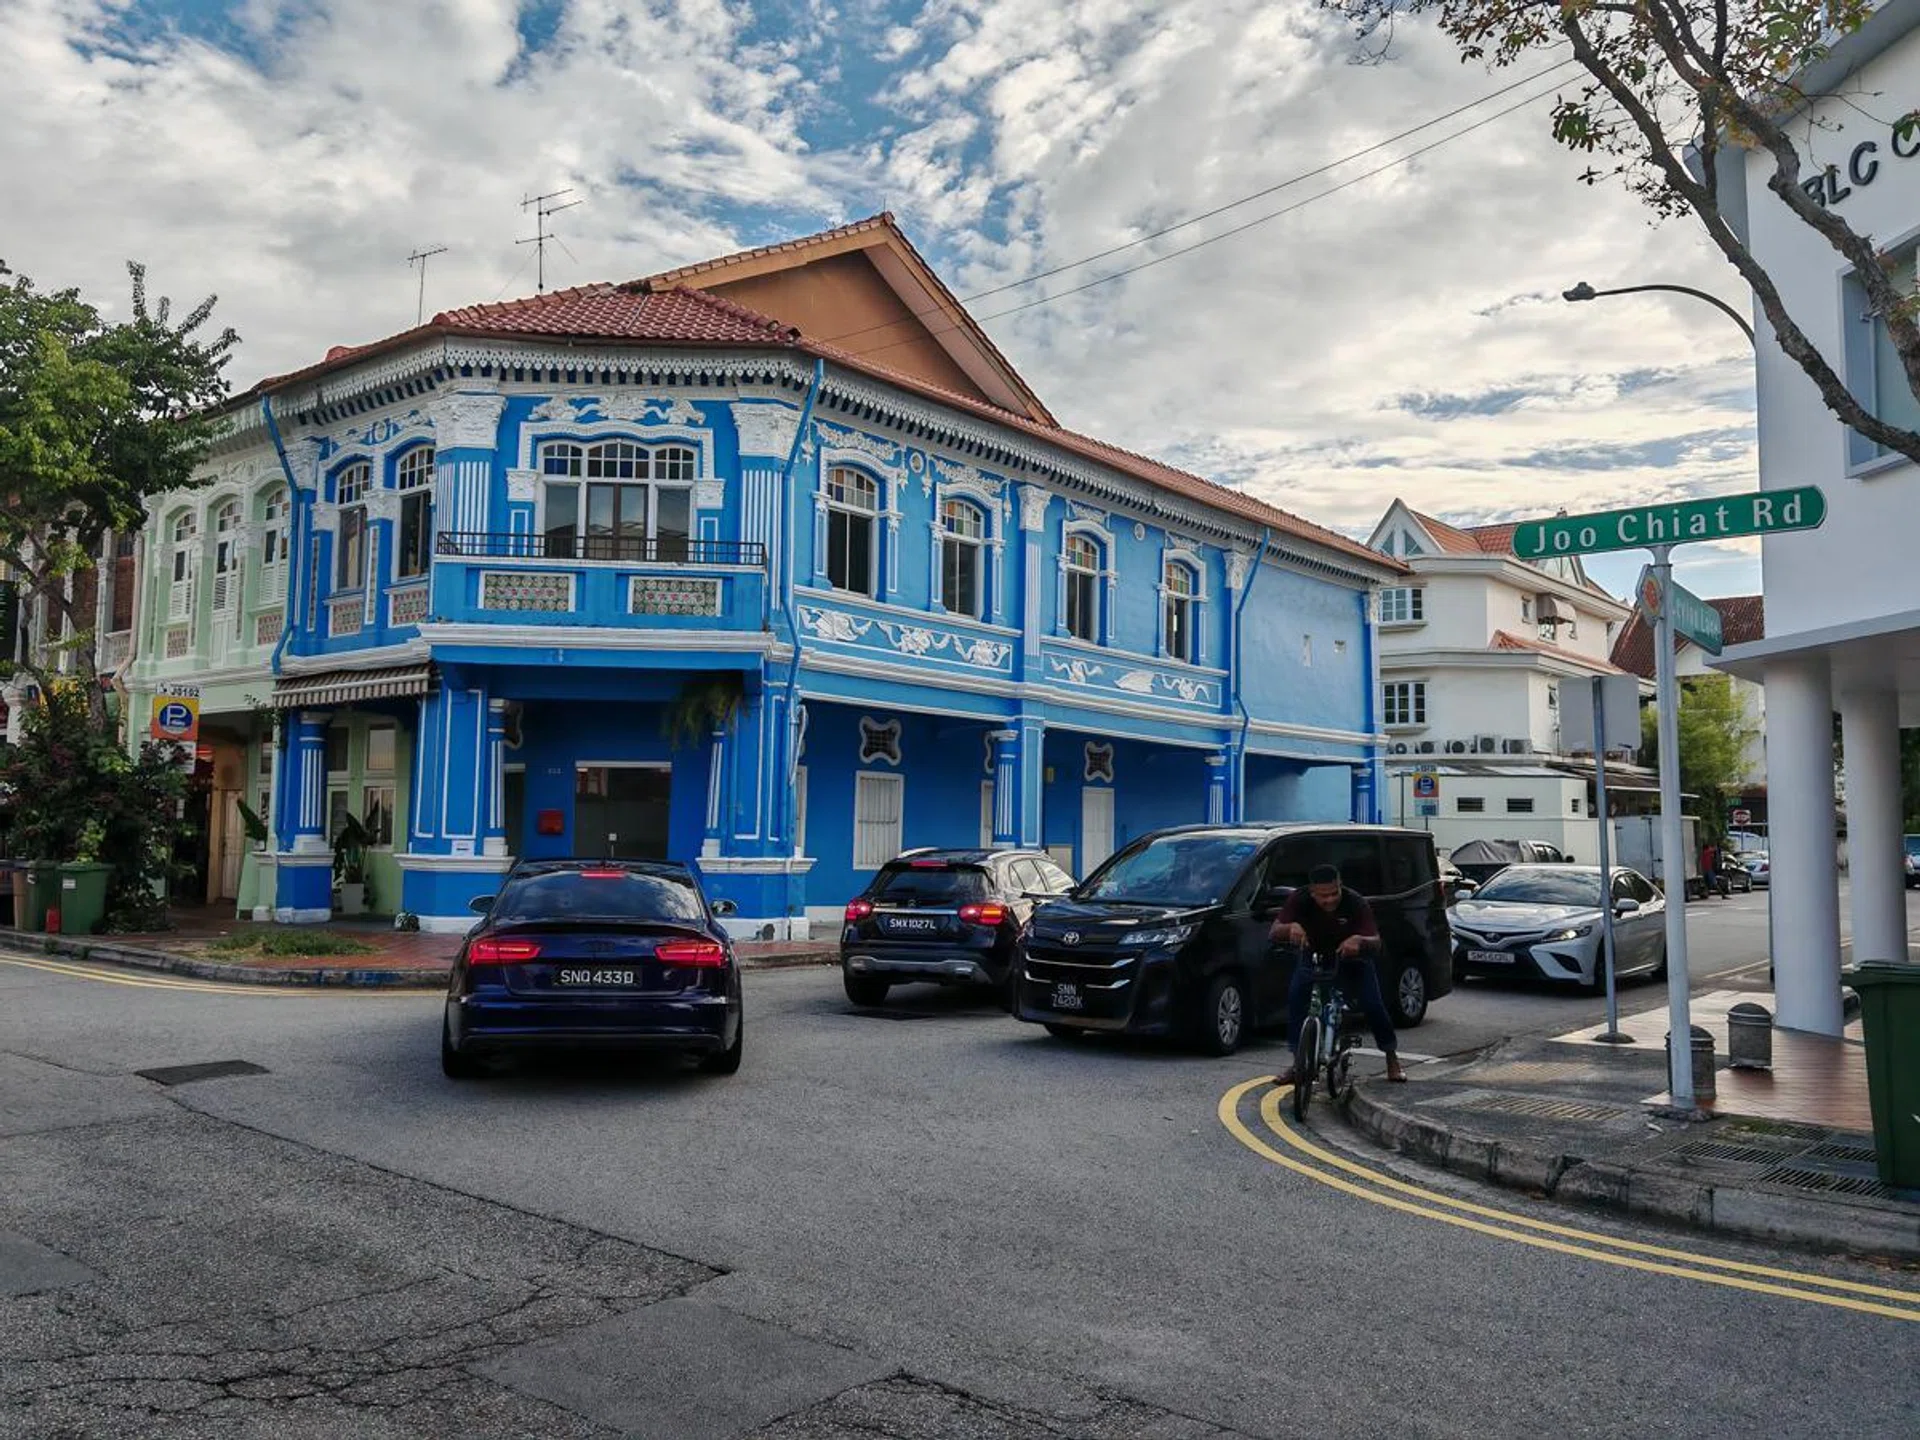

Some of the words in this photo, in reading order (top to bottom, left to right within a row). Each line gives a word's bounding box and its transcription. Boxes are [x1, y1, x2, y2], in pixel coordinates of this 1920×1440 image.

[1533, 525, 1597, 553] Joo
[1617, 504, 1730, 543] Chiat
[1752, 494, 1802, 528] Rd
